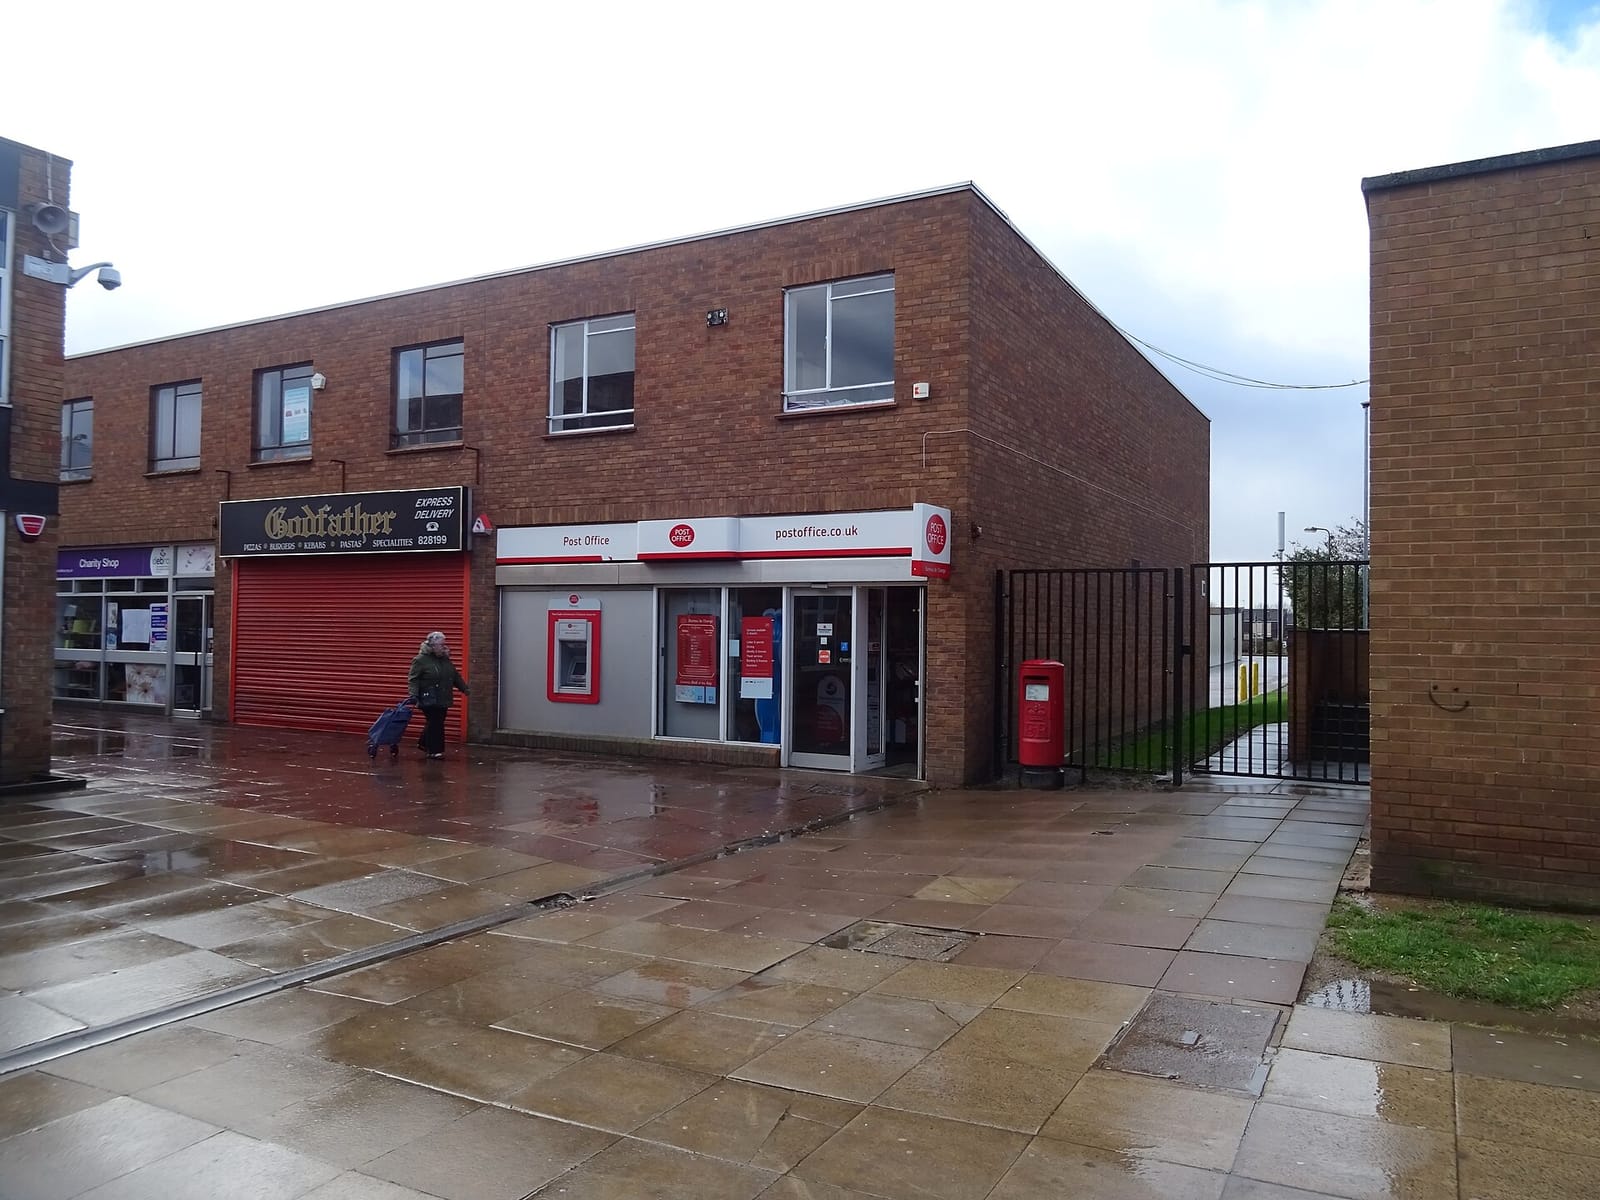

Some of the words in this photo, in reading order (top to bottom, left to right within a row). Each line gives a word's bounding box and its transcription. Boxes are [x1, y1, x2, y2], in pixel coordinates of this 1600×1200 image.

[415, 496, 454, 508] EXPRESS
[414, 508, 455, 520] DELIVERY
[264, 502, 397, 543] Godfather
[929, 521, 944, 534] POST
[674, 528, 690, 536] POST
[243, 543, 262, 552] PIZZAS
[269, 542, 296, 551] BURGERS
[303, 541, 327, 550] KEBABS
[340, 540, 363, 549] PASTAS
[372, 538, 414, 548] SPECIALITIES
[417, 535, 447, 546] 828199
[563, 536, 582, 547] Post
[584, 535, 610, 546] Office
[671, 535, 692, 543] OFFICE
[927, 533, 944, 546] OFFICE
[79, 558, 102, 569] Charity
[102, 557, 120, 569] Shop
